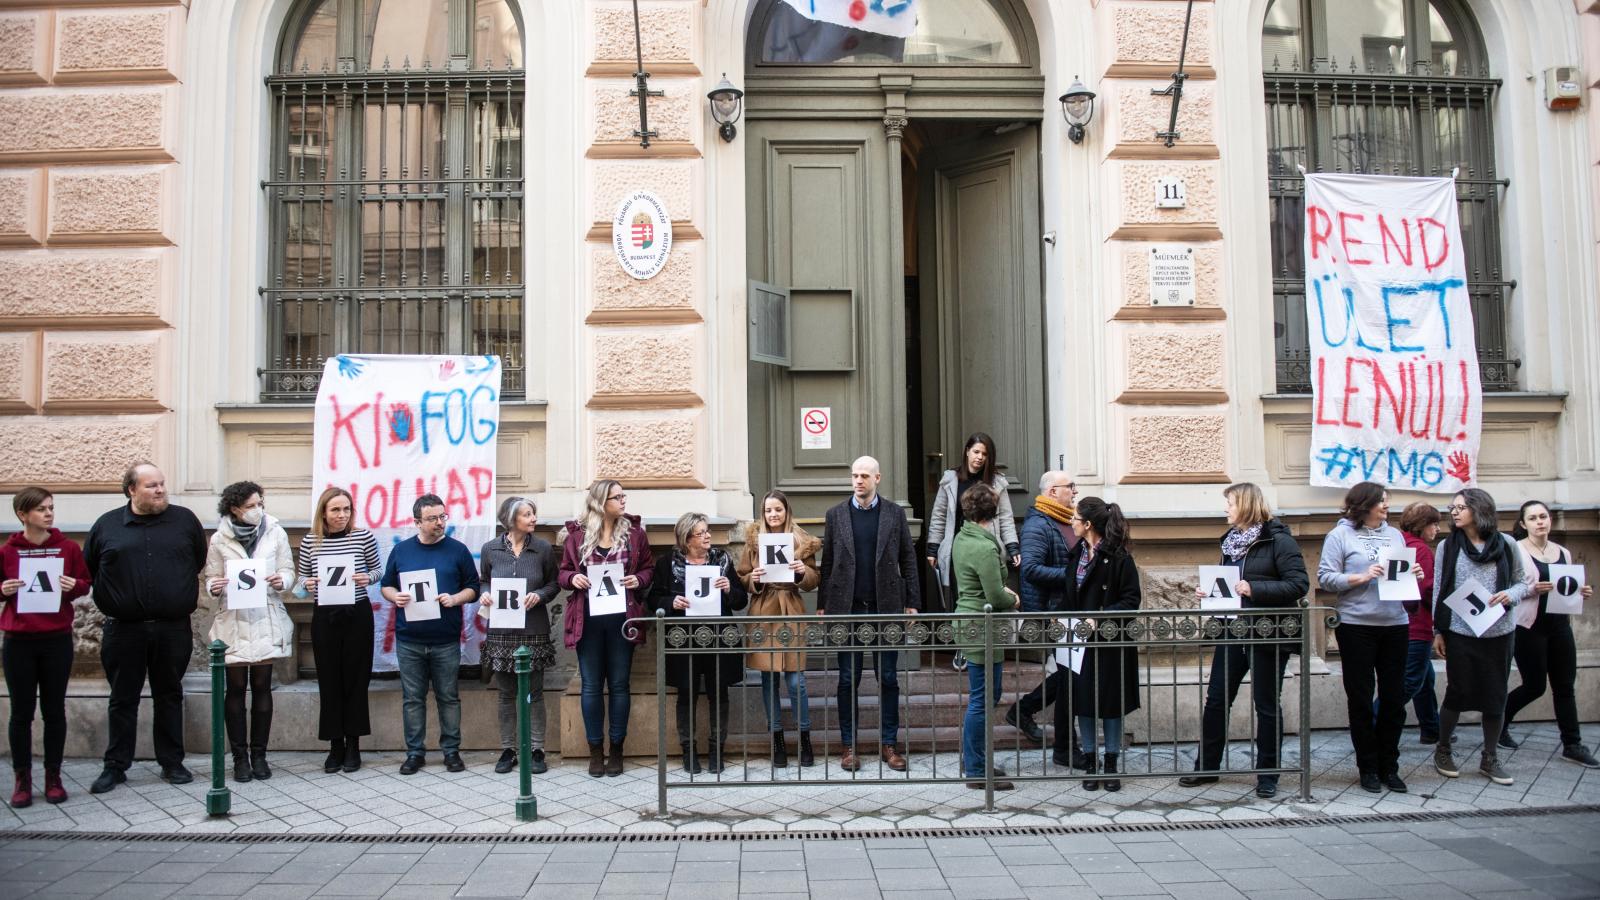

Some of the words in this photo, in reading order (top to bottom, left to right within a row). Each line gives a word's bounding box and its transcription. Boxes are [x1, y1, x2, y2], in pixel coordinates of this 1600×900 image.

[1163, 184, 1183, 199] 11.
[1307, 206, 1449, 273] REND
[1313, 273, 1464, 352] ÜLET
[1316, 355, 1470, 442] LENÜL!
[329, 392, 383, 470] KI
[421, 384, 496, 454] FOG
[1316, 444, 1444, 488] #VMG
[766, 544, 793, 565] K
[237, 568, 256, 591] S
[326, 566, 347, 587] Z
[1386, 559, 1410, 581] P
[27, 571, 54, 592] A
[408, 581, 431, 603] T
[595, 569, 619, 597] Á
[695, 576, 712, 598] J
[1209, 577, 1234, 599] A
[1556, 575, 1579, 597] O
[496, 589, 520, 610] R
[1463, 591, 1486, 616] J
